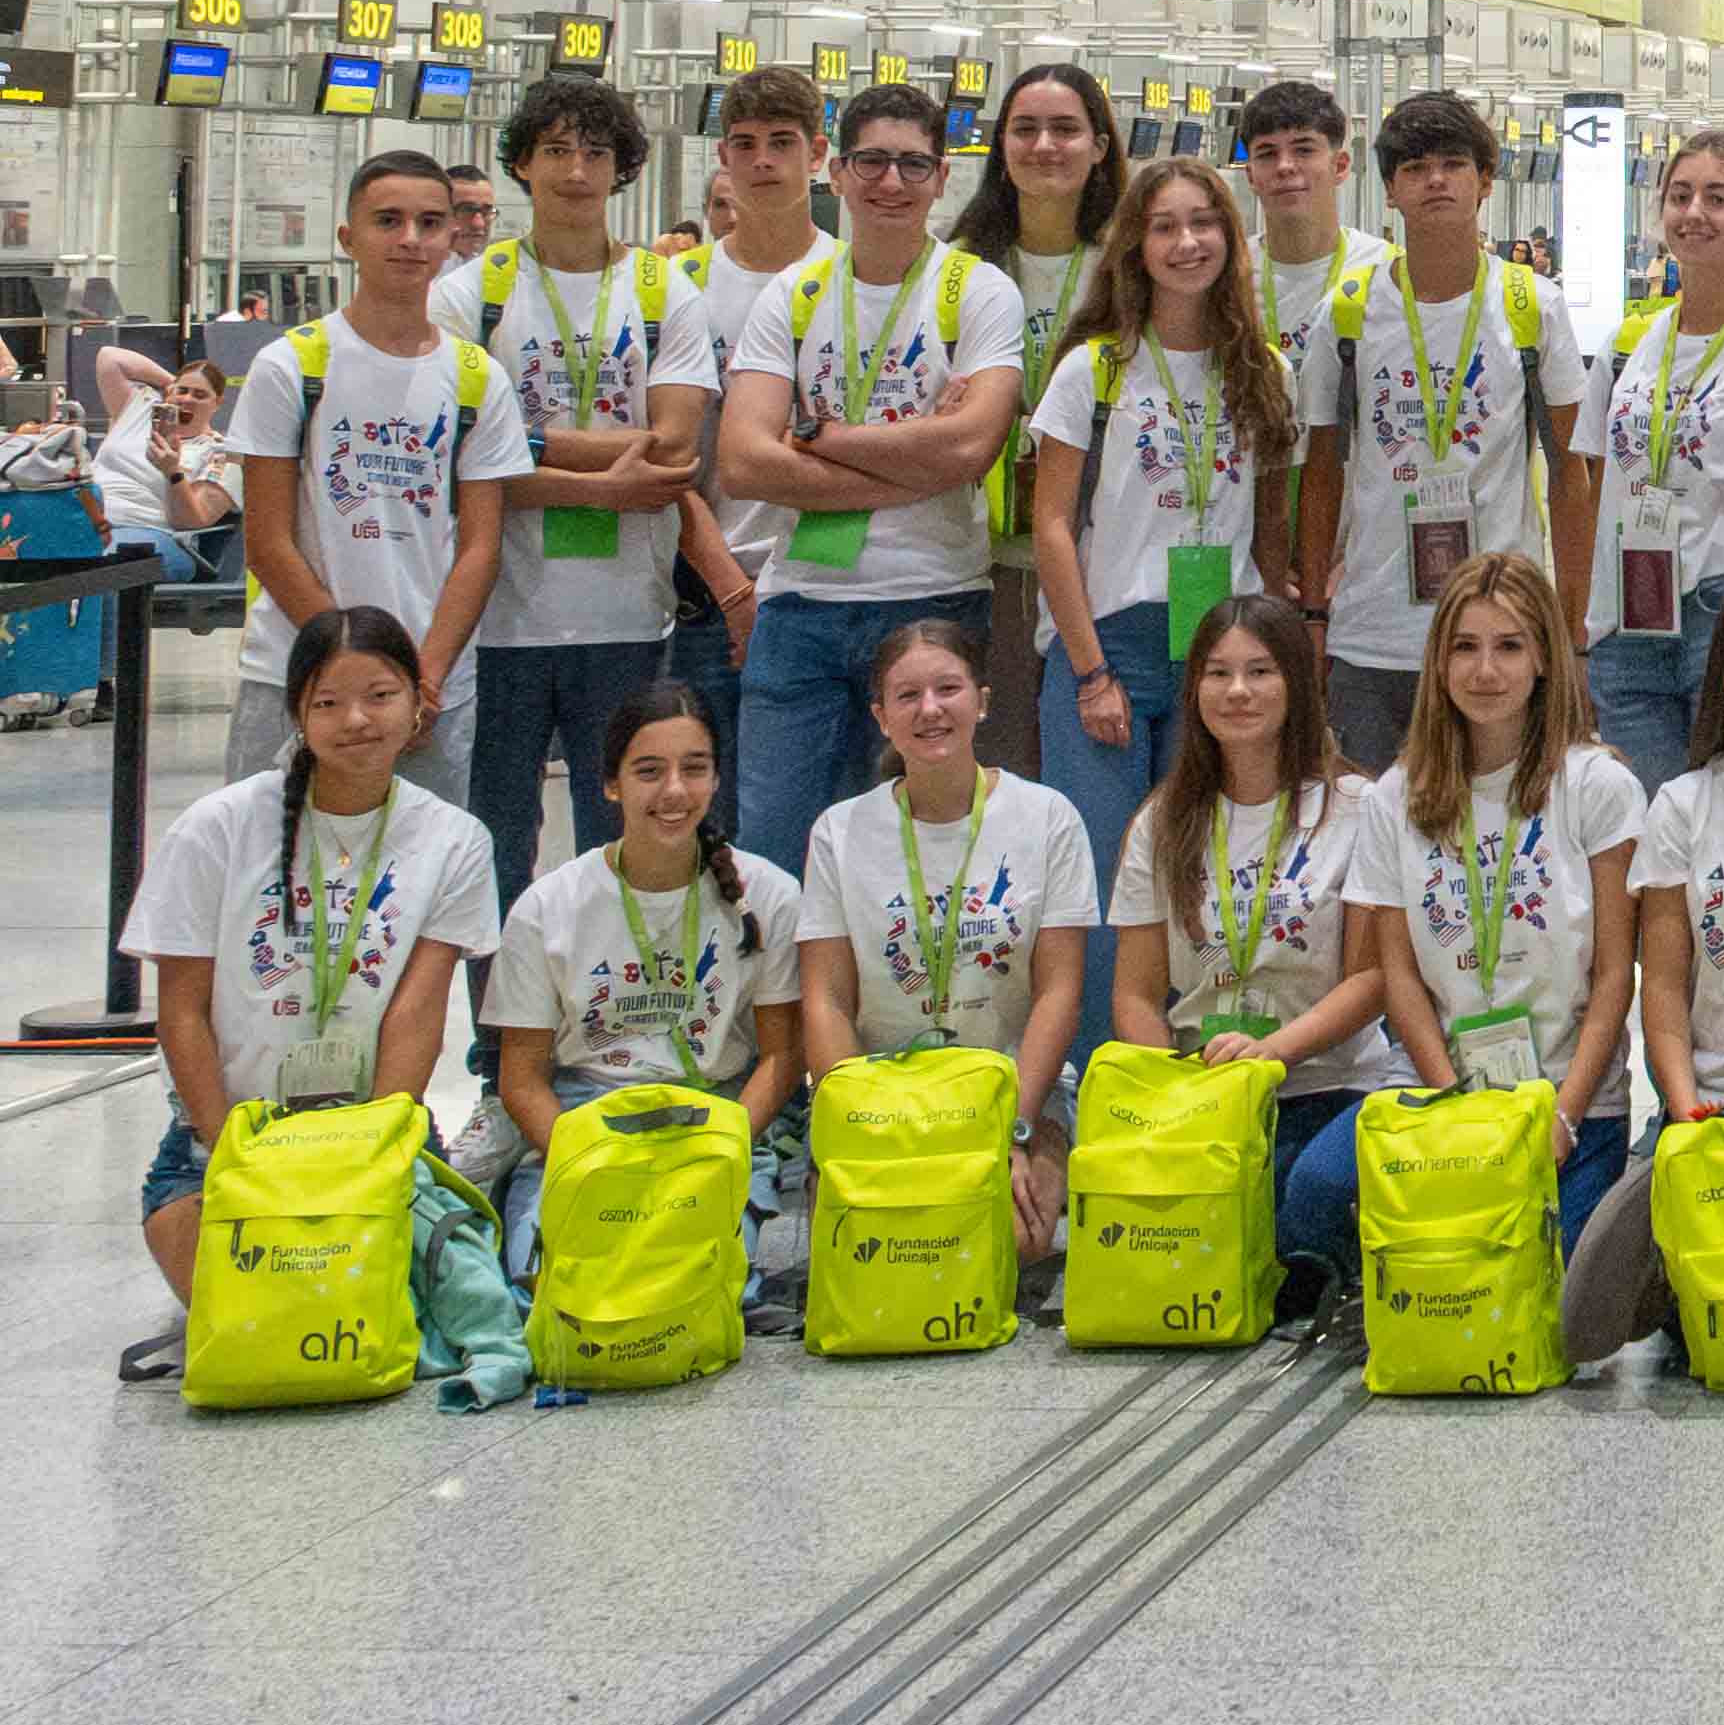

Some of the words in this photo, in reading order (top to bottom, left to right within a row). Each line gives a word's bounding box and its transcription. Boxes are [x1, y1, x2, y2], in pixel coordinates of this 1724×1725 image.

[349, 0, 394, 40] 307
[441, 11, 482, 49] 308
[565, 22, 601, 59] 309
[724, 39, 756, 72] 310
[819, 50, 847, 81] 311
[879, 56, 907, 85] 312
[959, 62, 984, 92] 313
[1146, 82, 1169, 109] 315
[1189, 87, 1212, 114] 316
